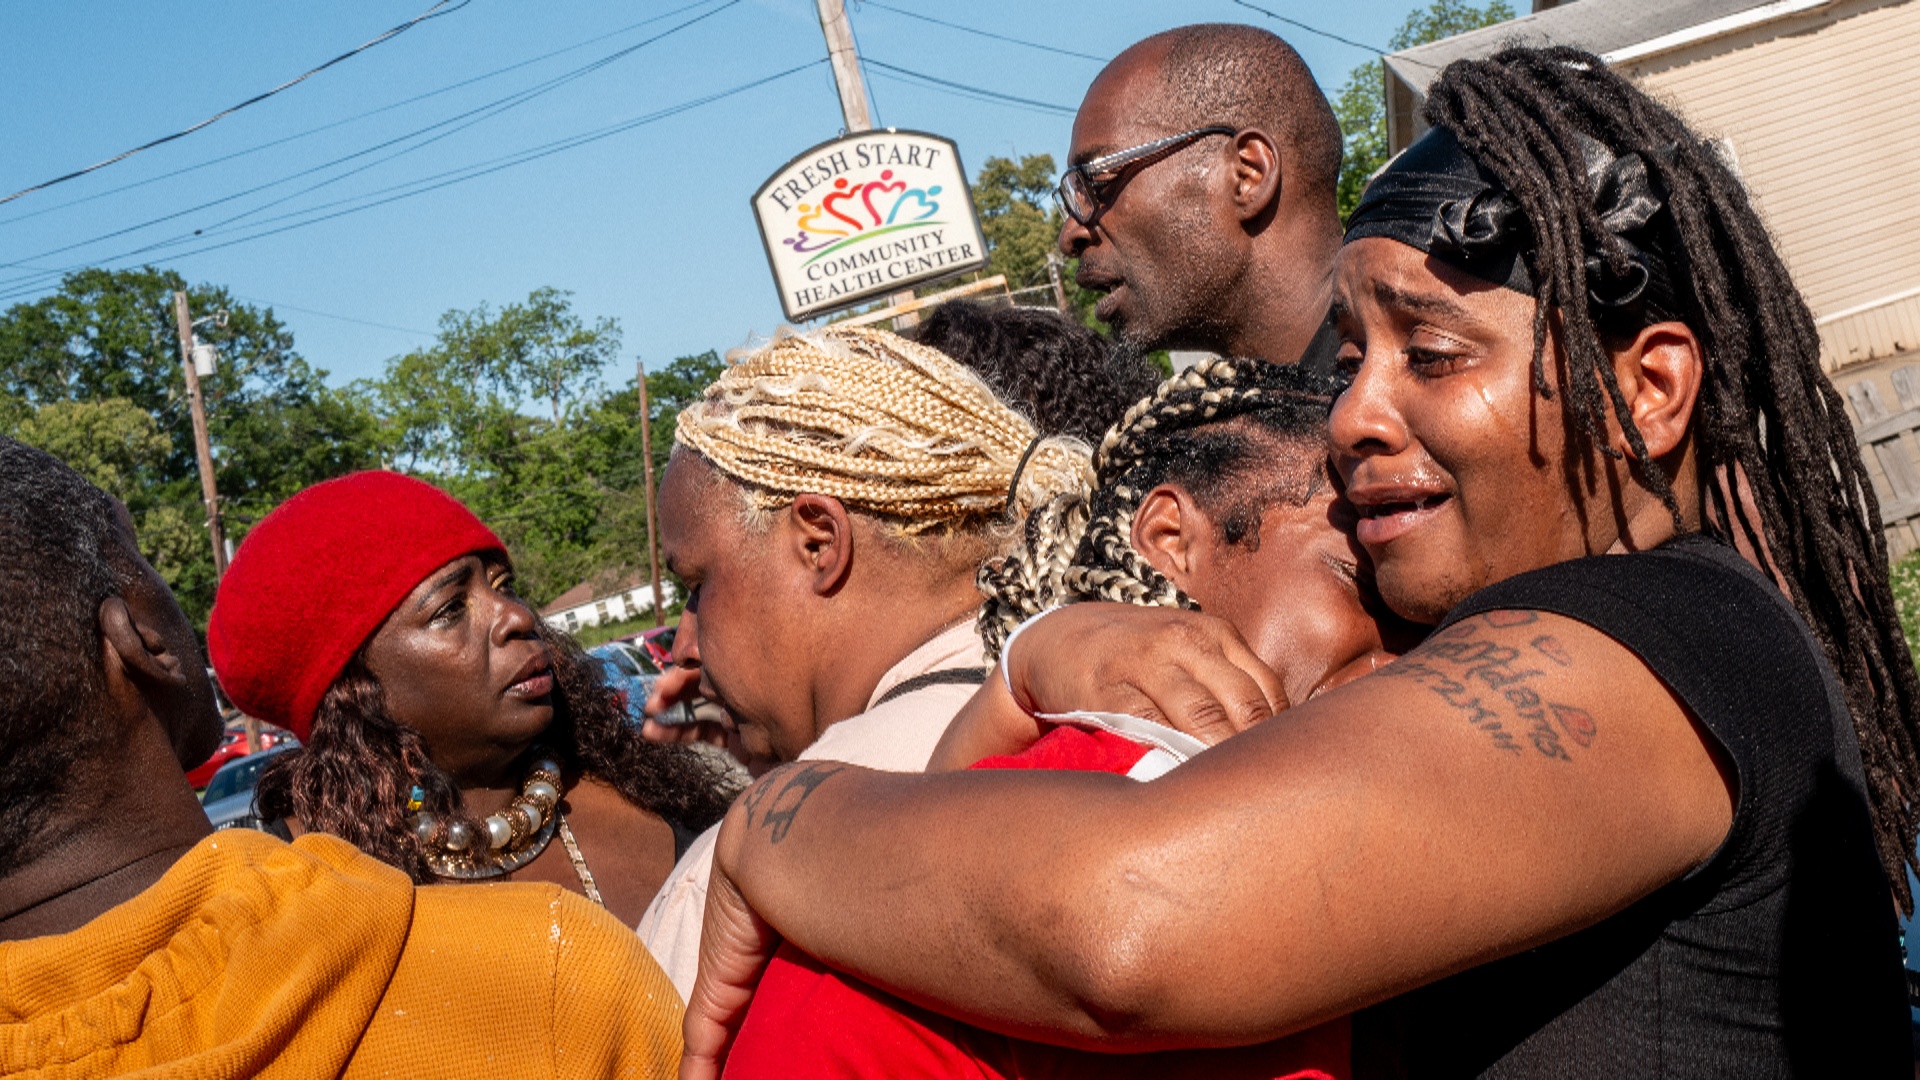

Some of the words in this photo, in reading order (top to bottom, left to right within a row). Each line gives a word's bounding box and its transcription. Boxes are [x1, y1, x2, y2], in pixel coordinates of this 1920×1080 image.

[769, 150, 852, 213] FRESH
[856, 142, 941, 170] START
[794, 268, 883, 308] HEALTH
[887, 243, 975, 280] CENTER
[806, 229, 945, 282] COMMUNITY
